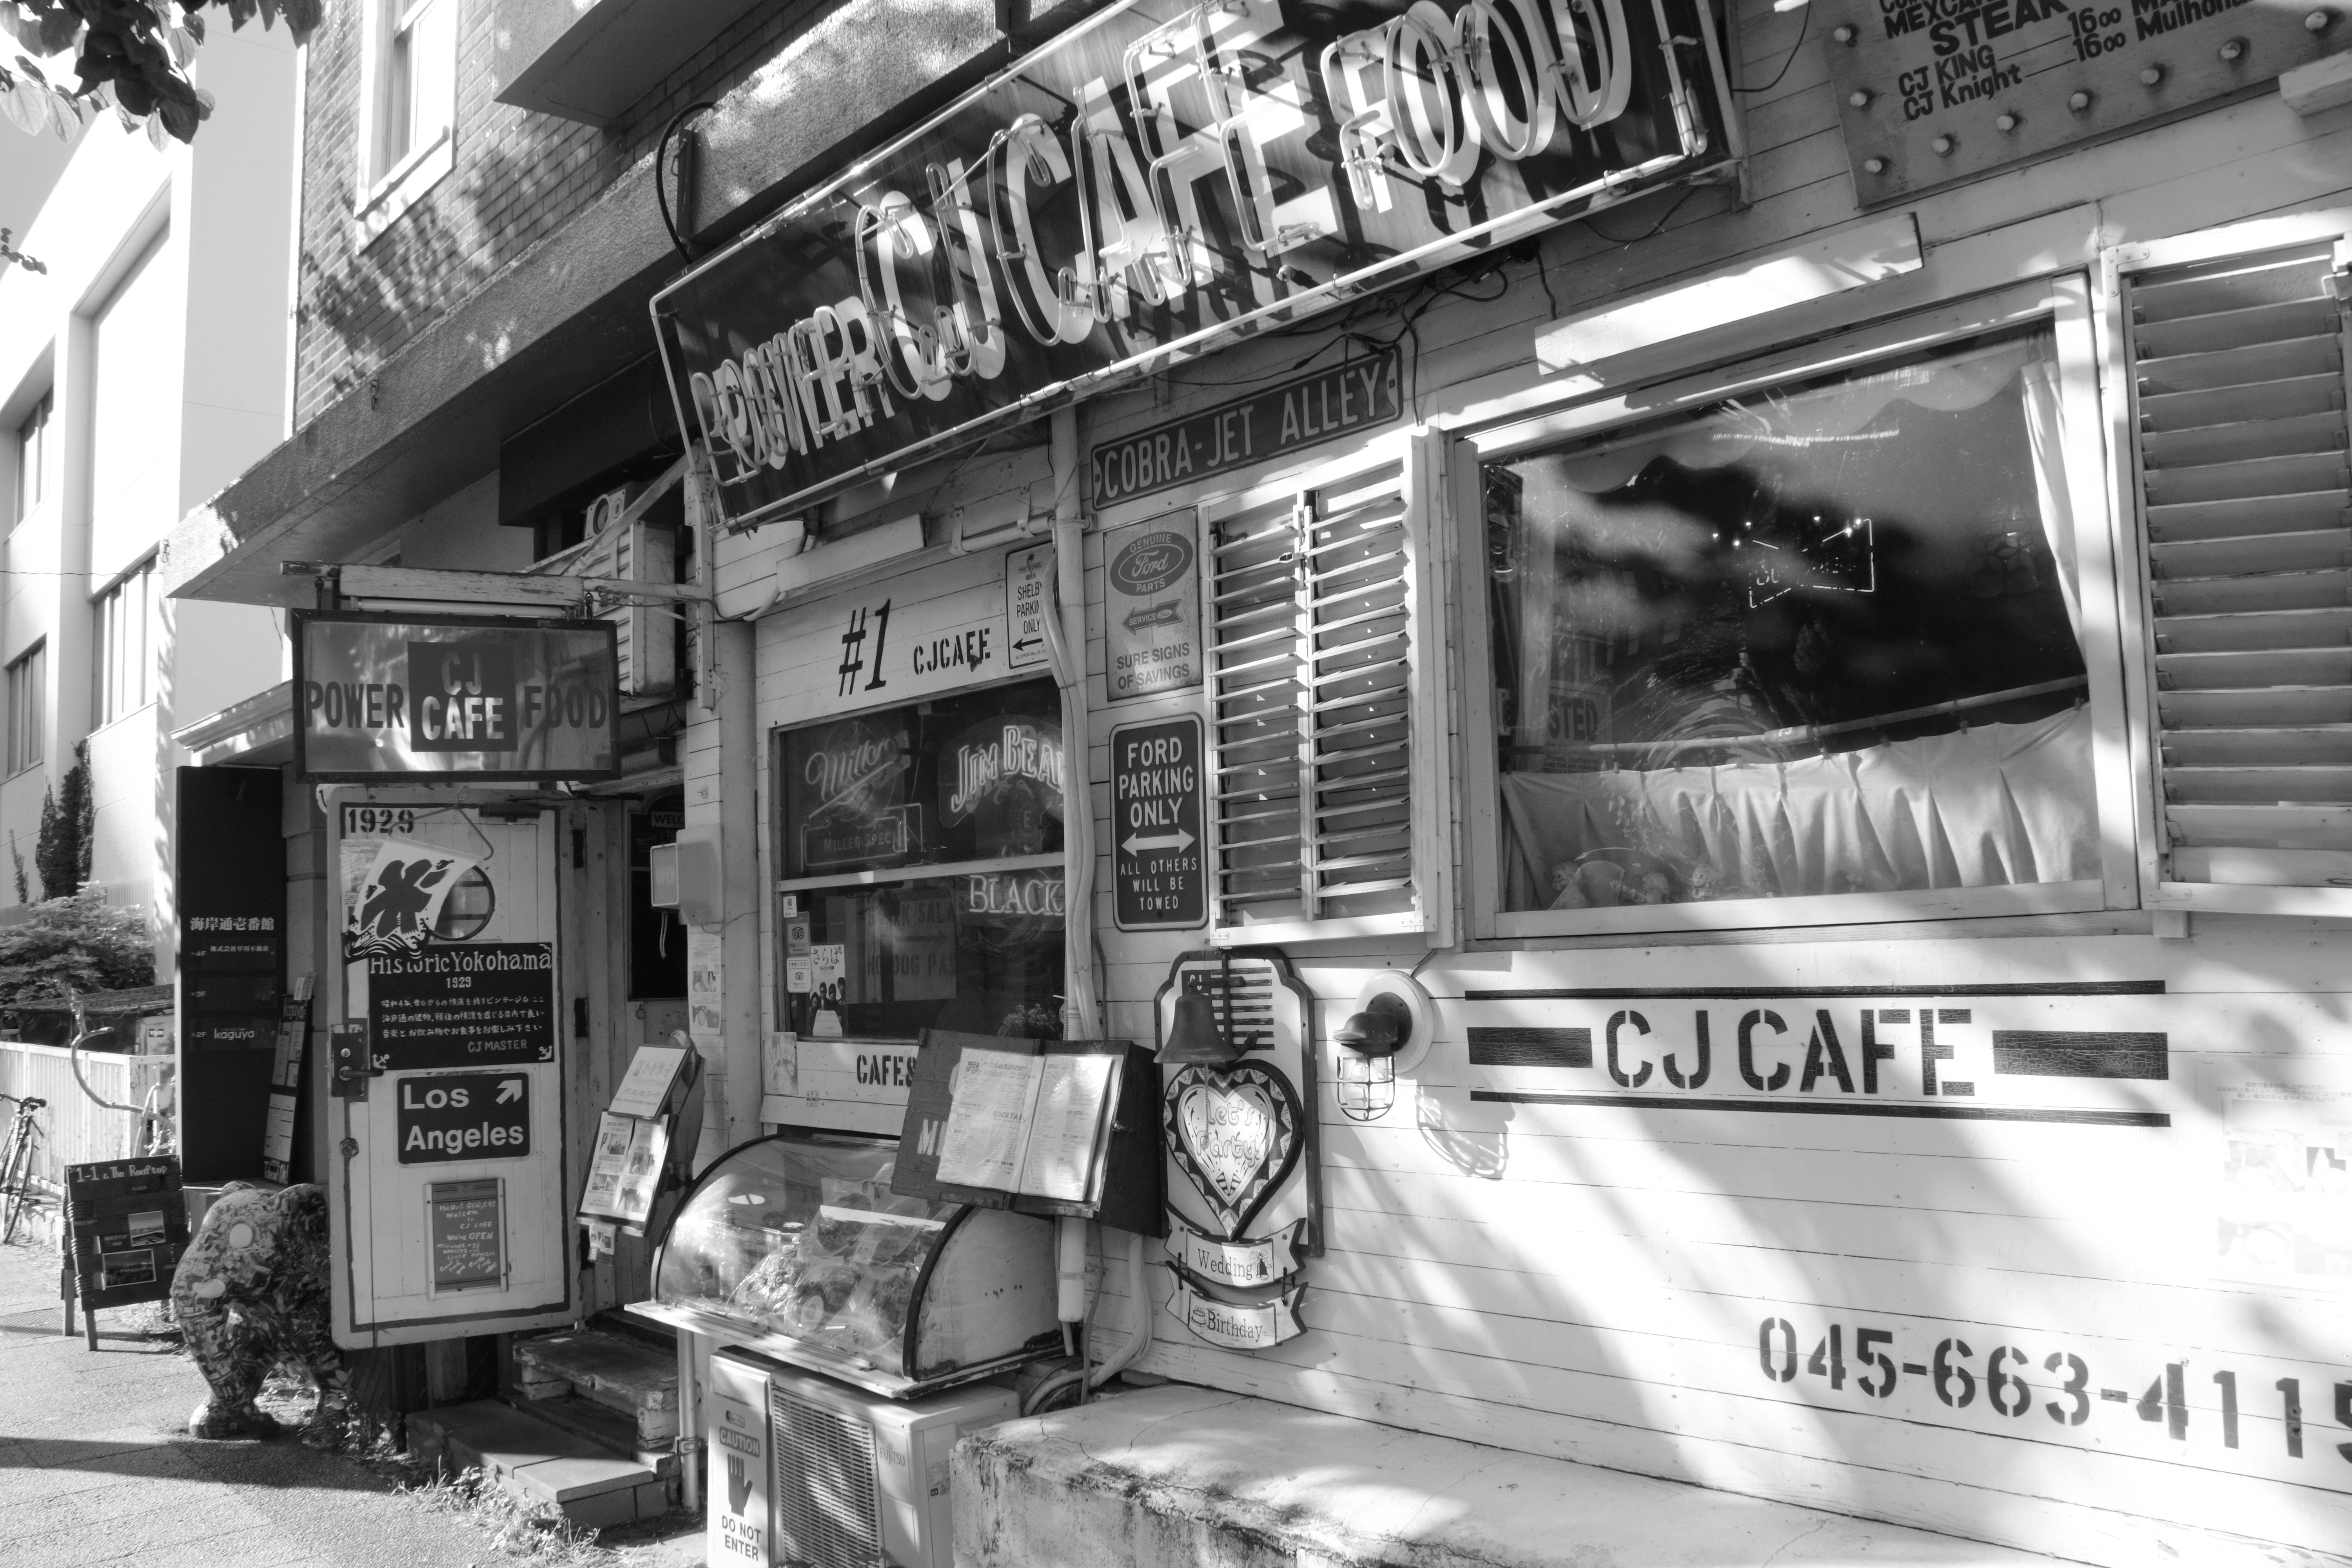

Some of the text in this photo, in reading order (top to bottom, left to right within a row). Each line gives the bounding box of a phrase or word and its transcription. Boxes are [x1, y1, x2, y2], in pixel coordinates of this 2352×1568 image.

[1898, 66, 1929, 97] CJ
[1935, 44, 1996, 85] KING
[1904, 90, 1933, 120] CJ
[1940, 64, 2022, 109] Knight
[691, 0, 1632, 485] POWER CJ CAFE FOOD
[1104, 361, 1381, 499] COBRA-JET ALLEY
[1129, 534, 1172, 553] GENUINE
[1131, 550, 1169, 577] Ford
[1136, 578, 1165, 592] PARTS
[1024, 618, 1040, 635] ONLY
[1129, 612, 1156, 626] SERVICE
[838, 598, 891, 697] #1
[1117, 642, 1190, 670] SURE SIGNS
[441, 650, 482, 695] CJ
[1118, 662, 1190, 690] OF SAVINGS
[305, 681, 405, 728] POWER
[524, 685, 607, 730] FOOD
[421, 696, 504, 741] CAFE
[1127, 737, 1182, 769] FORD
[806, 738, 894, 802] Miller
[951, 743, 998, 813] JIM
[1119, 764, 1194, 800] PARKING
[653, 814, 684, 824] WELC
[1130, 797, 1183, 828] ONLY
[1120, 857, 1197, 875] ALL OTHERS
[969, 875, 1065, 916] BLACK
[1132, 877, 1184, 893] WILL BE
[1140, 895, 1179, 911] TOWED
[190, 917, 274, 931] 海岸通壱番館
[454, 951, 552, 973] Yokohama
[812, 946, 842, 965] さらば
[446, 976, 472, 988] 1929
[214, 1028, 254, 1040] kaguya
[468, 1039, 528, 1053] CJ MASTER
[1605, 1009, 1976, 1096] CJ CAFE
[404, 1084, 470, 1109] Los
[993, 1111, 1026, 1122] COCKTAIL
[1206, 1099, 1255, 1126] Let's
[405, 1121, 524, 1154] Angeles
[1196, 1131, 1261, 1167] Party!
[110, 1166, 124, 1178] The
[129, 1165, 167, 1176] Rooftop
[468, 1232, 494, 1240] OPEN
[1197, 1247, 1253, 1279] Wedding
[1207, 1308, 1263, 1341] Birthday
[720, 1429, 760, 1455] CAUTION
[879, 1446, 906, 1466] FUJITSU
[722, 1514, 761, 1543] DO NOT
[724, 1534, 759, 1561] ENTER
